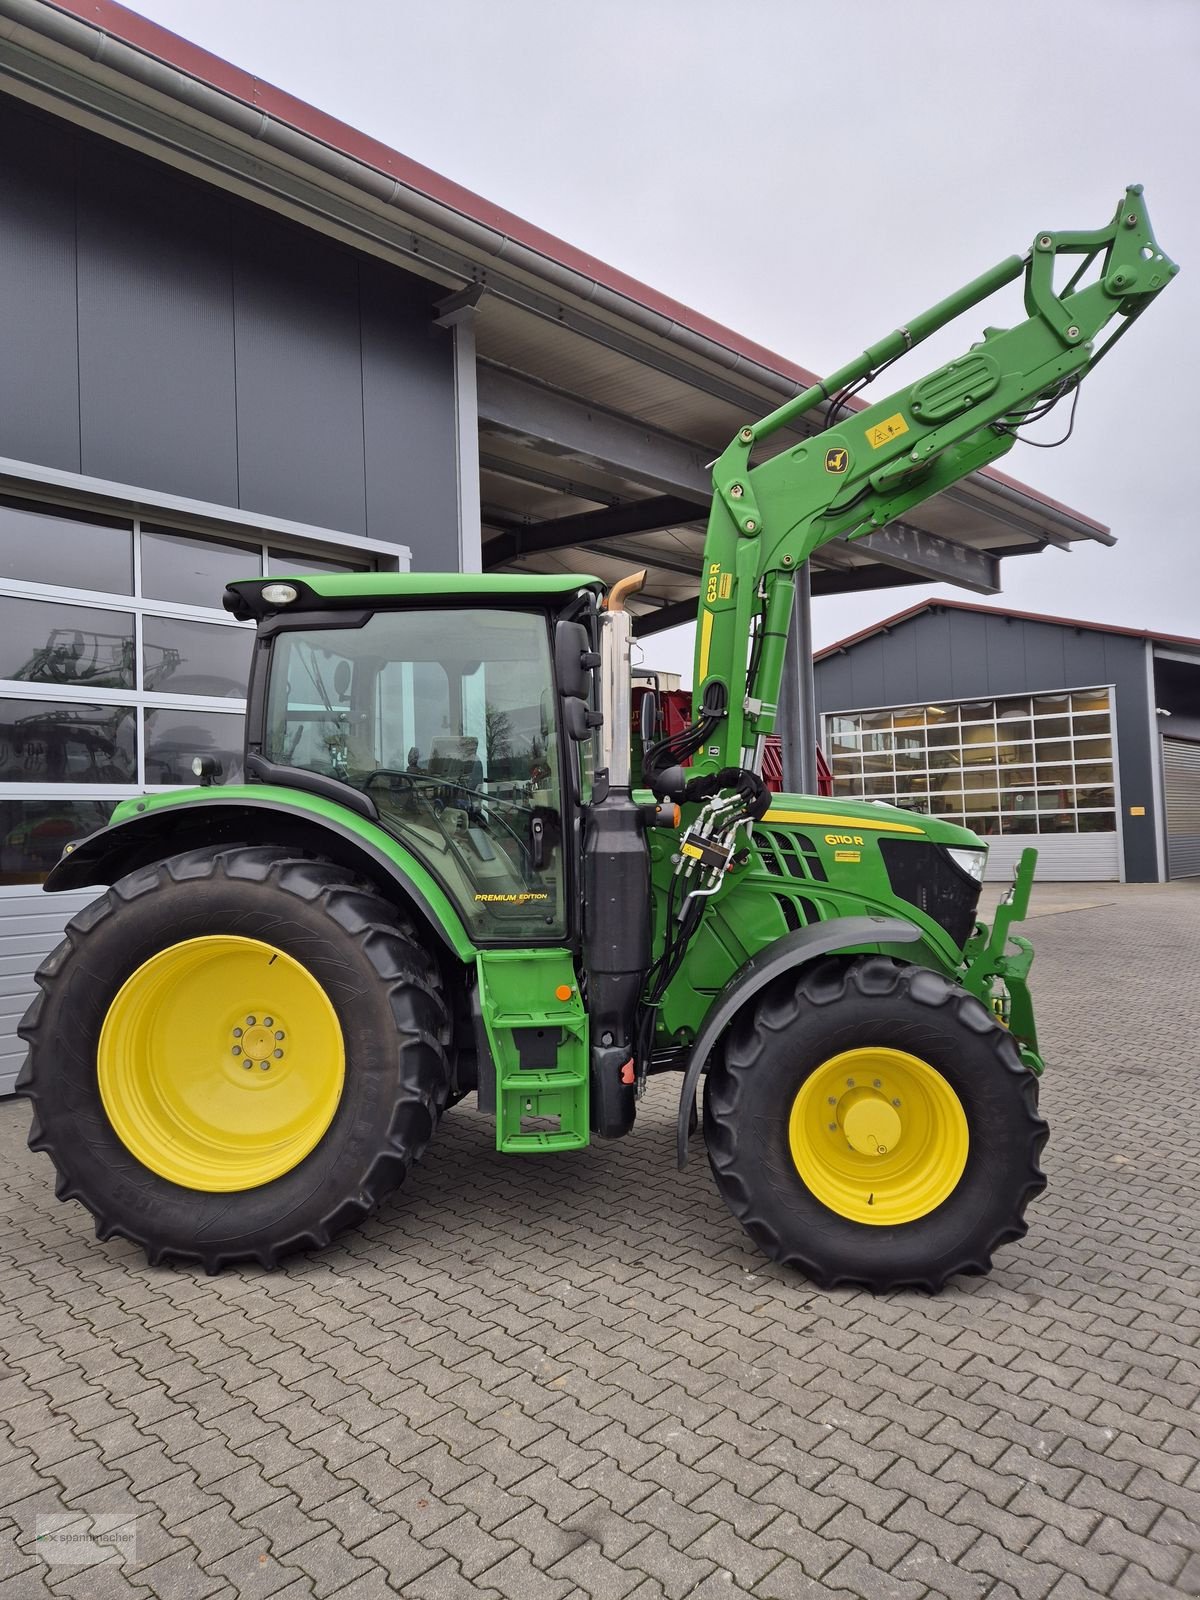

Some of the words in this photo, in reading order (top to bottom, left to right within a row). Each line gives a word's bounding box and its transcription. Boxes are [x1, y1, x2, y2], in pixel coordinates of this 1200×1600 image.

[709, 563, 721, 574] R
[706, 576, 717, 602] 623
[824, 834, 853, 845] 6110
[853, 836, 865, 846] R
[474, 894, 517, 902] PREMIUM
